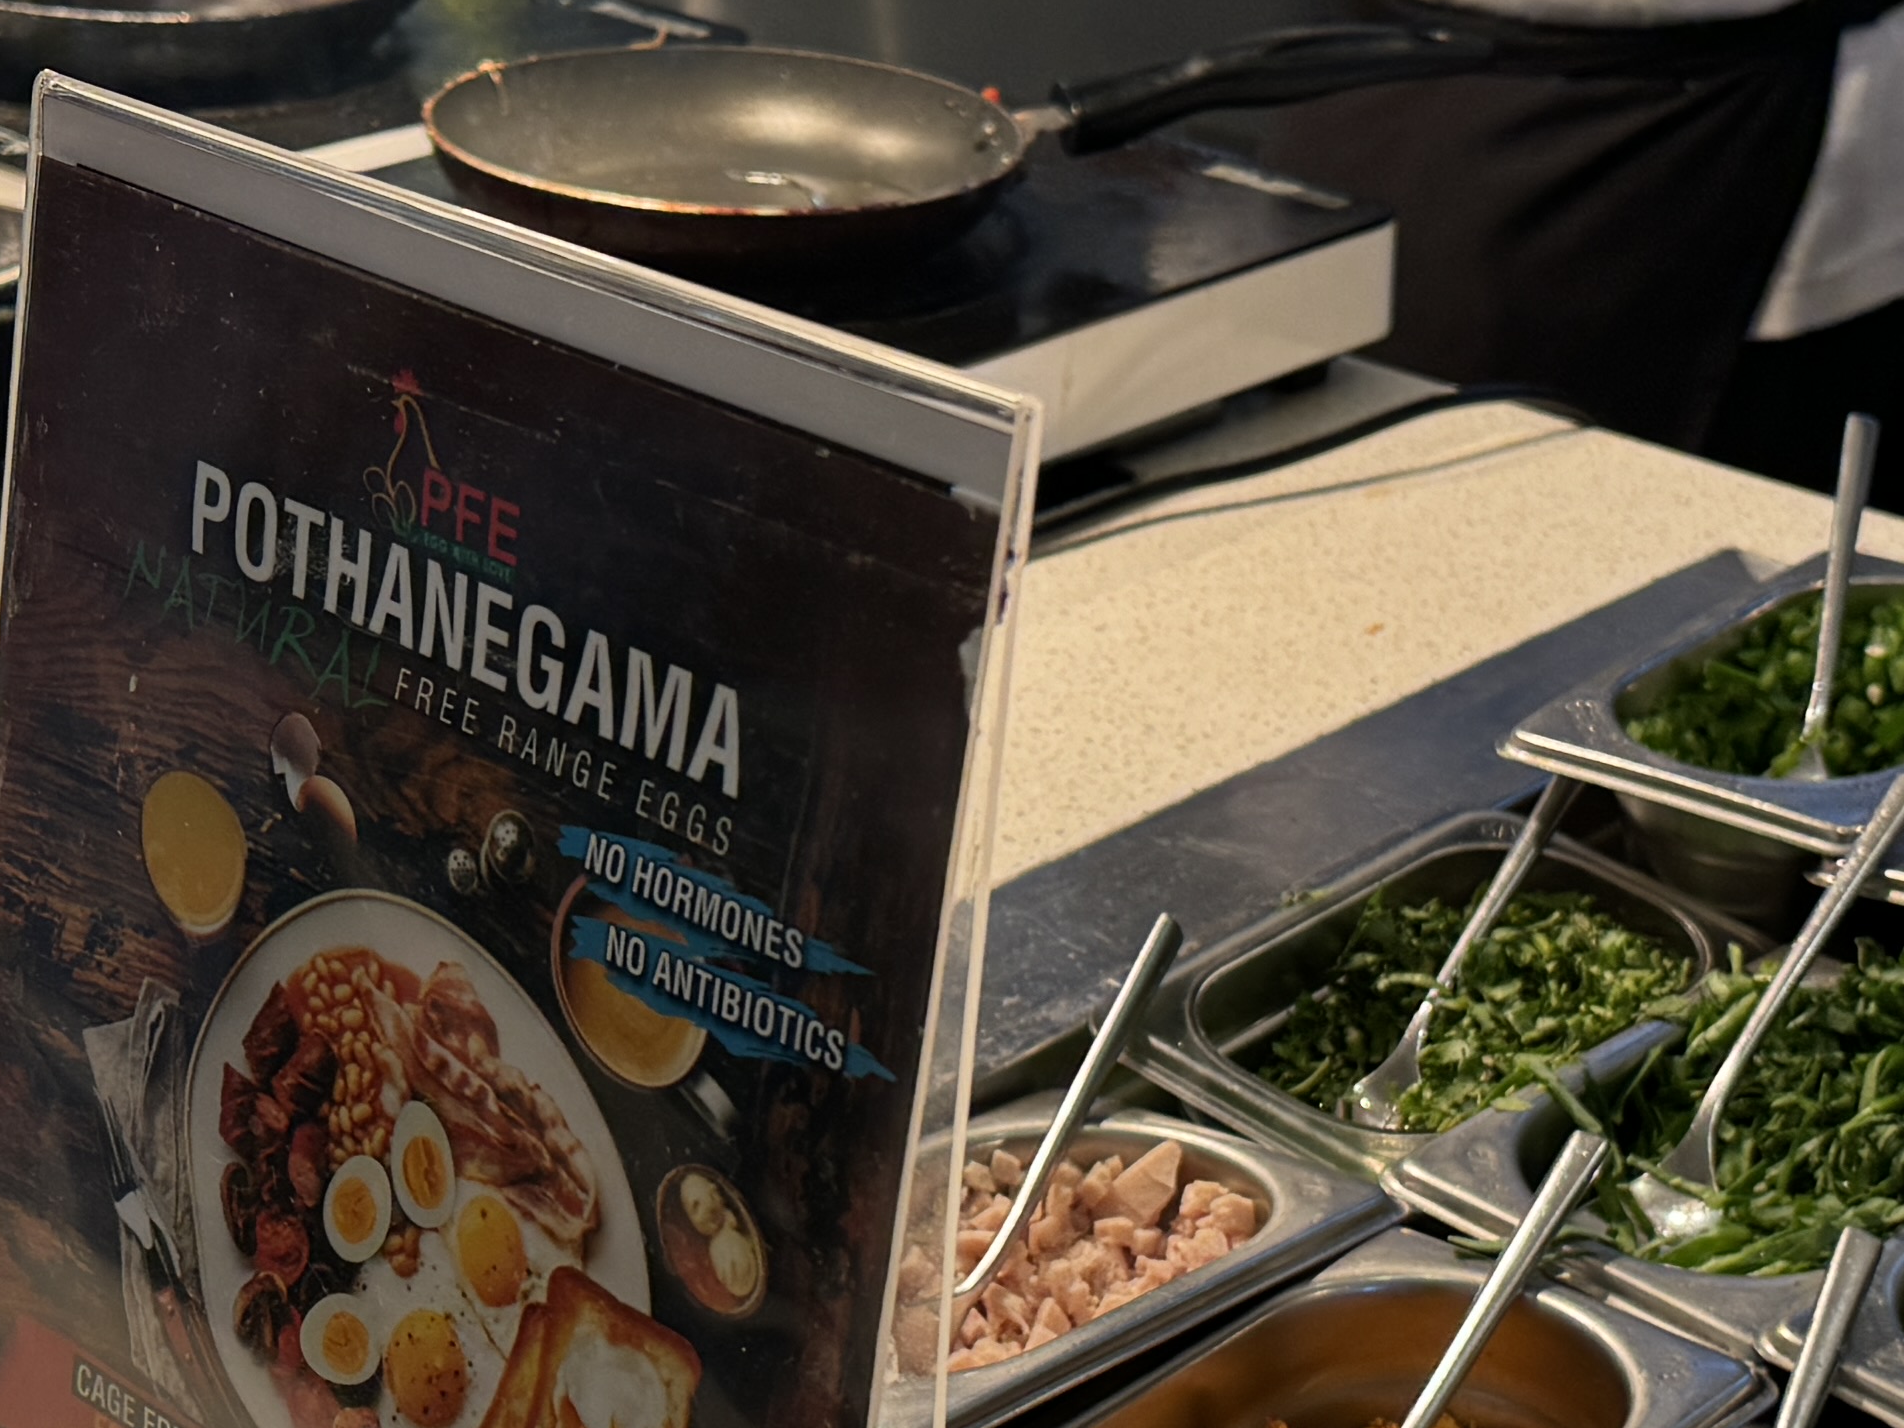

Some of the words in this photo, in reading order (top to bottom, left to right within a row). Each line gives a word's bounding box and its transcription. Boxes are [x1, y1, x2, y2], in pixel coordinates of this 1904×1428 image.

[421, 466, 520, 566] PFE
[125, 540, 389, 709] NATURAL
[192, 460, 739, 799] POTHANEGAMA
[395, 667, 480, 735] FREE
[498, 715, 617, 800] RANGE
[635, 779, 732, 856] EGGS
[584, 833, 626, 884] NO
[632, 856, 804, 969] HORMONES
[605, 925, 646, 976] NO
[652, 951, 845, 1071] ANTIBIOTICS
[76, 1364, 135, 1428] CAGE
